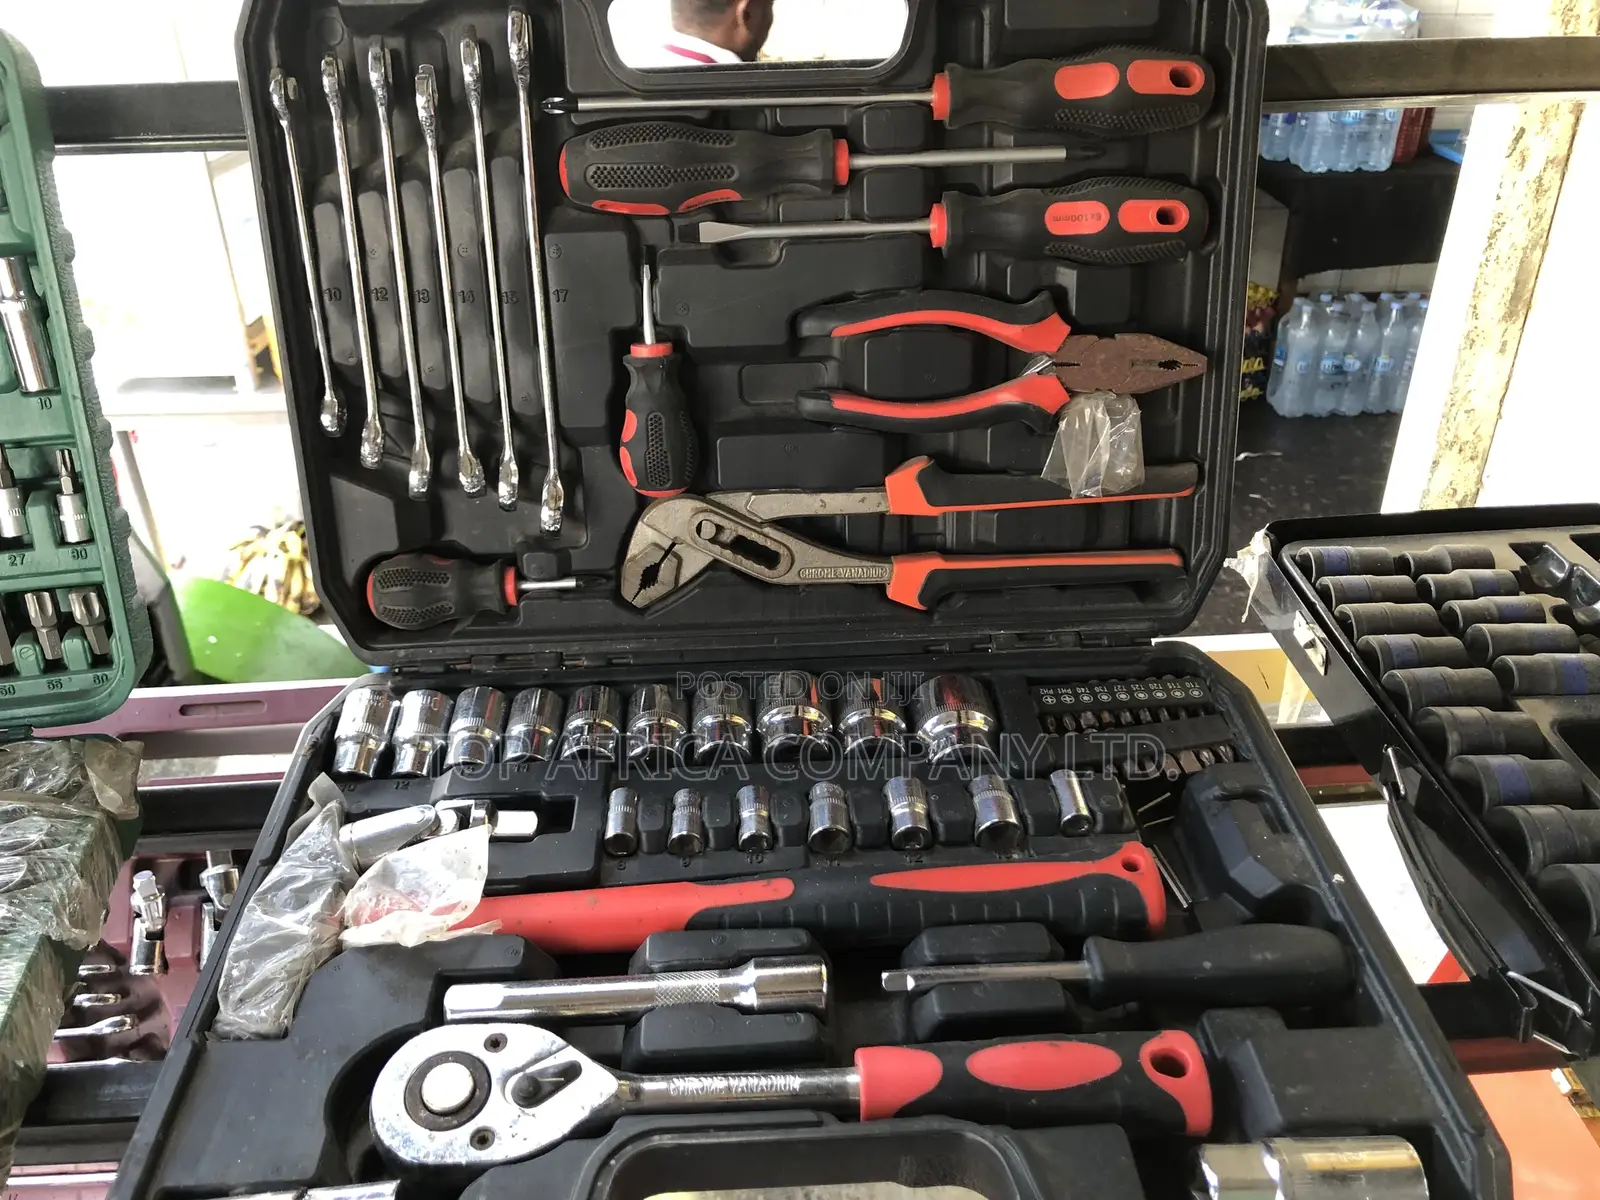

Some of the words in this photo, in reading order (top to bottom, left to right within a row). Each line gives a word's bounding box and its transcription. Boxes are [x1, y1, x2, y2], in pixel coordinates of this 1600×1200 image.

[325, 286, 342, 302] 10
[371, 286, 389, 302] 12
[415, 288, 430, 303] 13
[552, 288, 569, 302] 17
[37, 395, 54, 410] 10
[8, 553, 26, 566] 27
[69, 547, 88, 561] 30
[45, 678, 63, 691] 55
[669, 1075, 727, 1097] CHROME
[728, 1073, 801, 1096] VANADIUM
